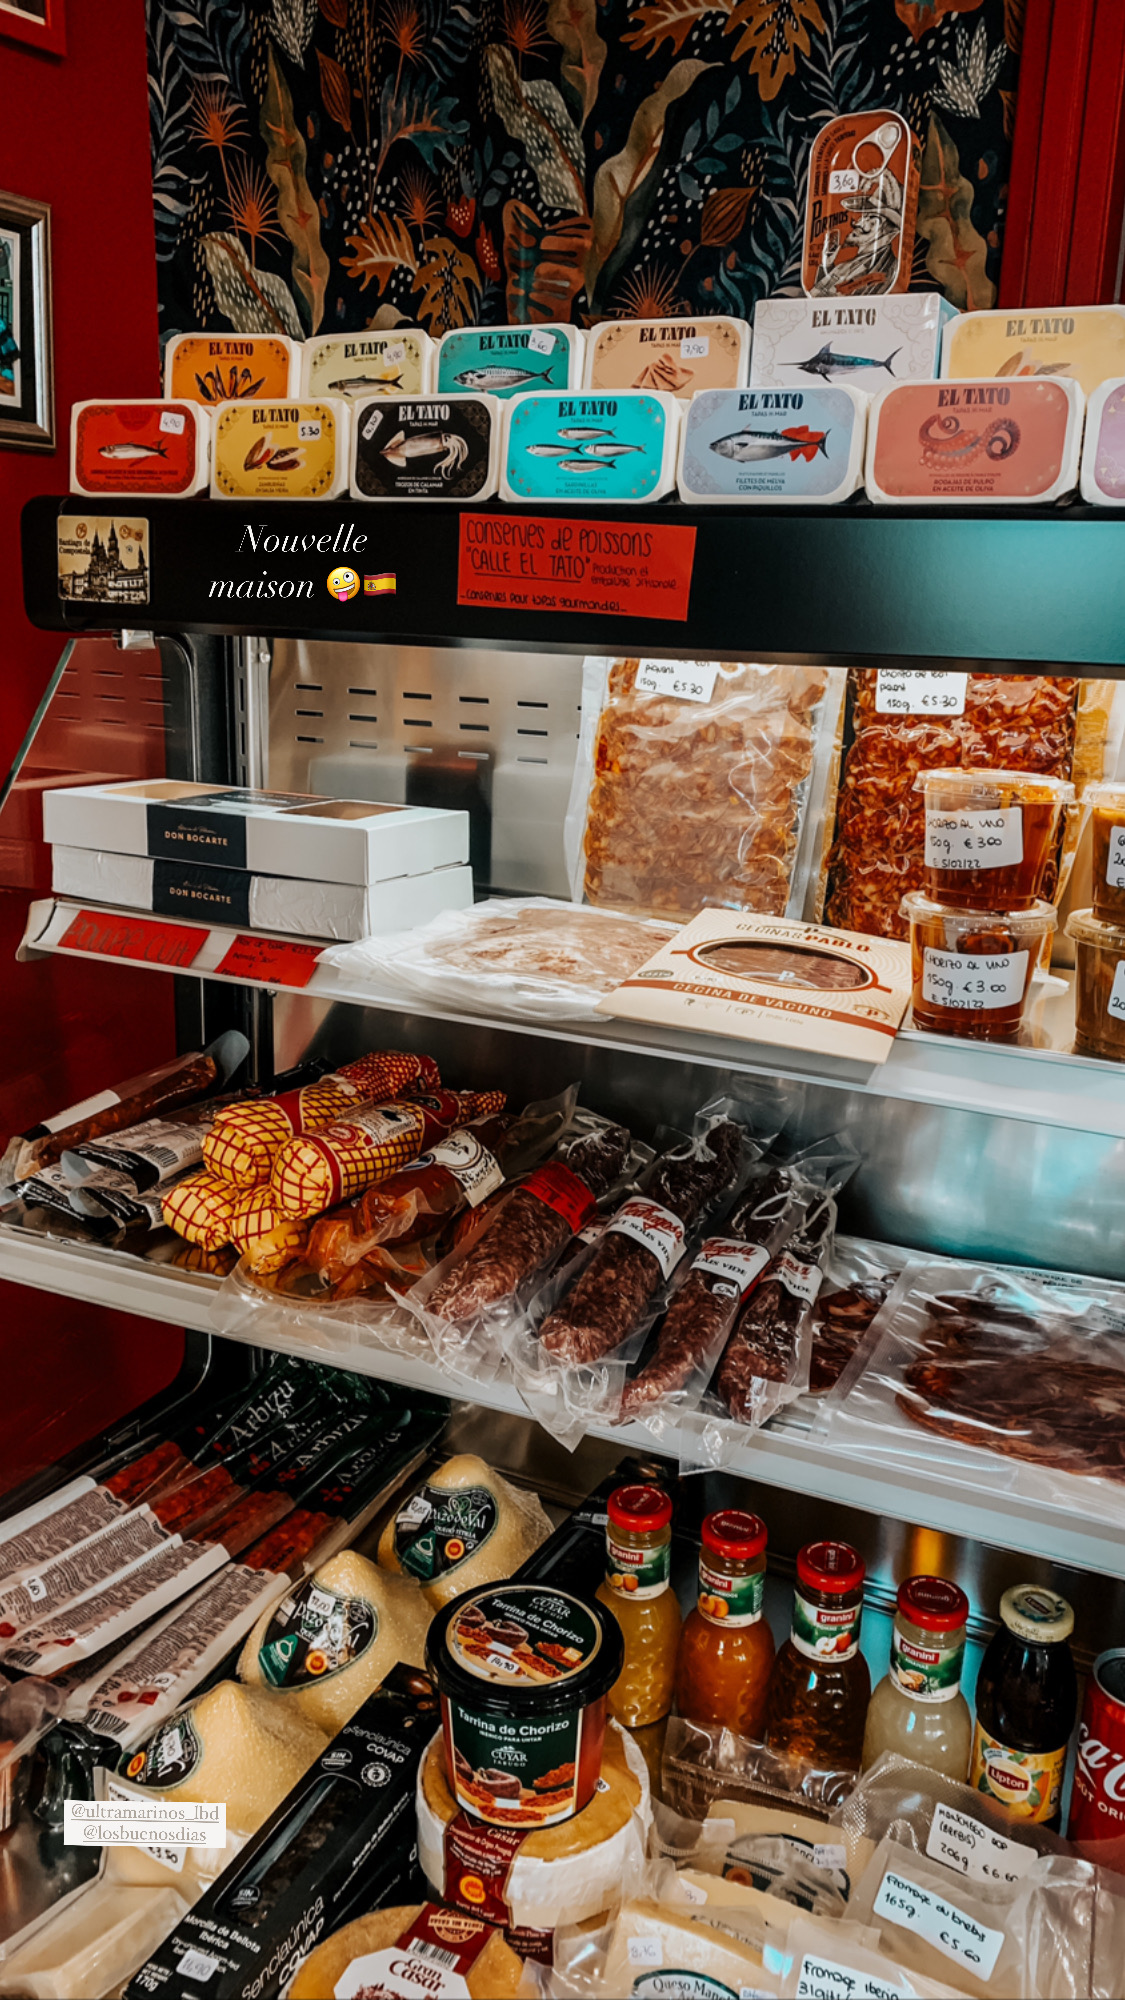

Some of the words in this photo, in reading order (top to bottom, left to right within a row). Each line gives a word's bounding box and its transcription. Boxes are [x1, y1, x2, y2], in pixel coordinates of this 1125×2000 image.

[812, 309, 831, 328] EL
[832, 308, 877, 327] TATO
[1006, 319, 1025, 337] EL
[1027, 317, 1075, 335] TATO
[479, 335, 496, 351] EL
[497, 333, 530, 349] TATO
[639, 327, 658, 343] EL
[659, 326, 696, 341] TATO
[209, 342, 222, 357] EL
[223, 341, 254, 356] TATO
[344, 343, 359, 359] EL
[359, 341, 388, 356] TATO
[738, 393, 759, 411] EL
[761, 392, 803, 411] TATO
[938, 388, 960, 407] EL
[963, 387, 1011, 406] TATO
[252, 408, 267, 424] EL
[268, 407, 300, 424] TATO
[398, 405, 415, 422] EL
[416, 404, 450, 421] TATO
[557, 400, 577, 418] EL
[578, 400, 618, 417] TATO
[520, 552, 537, 575] EL
[164, 830, 184, 841] DON
[186, 833, 229, 847] BOCARTE
[169, 886, 189, 897] DON
[191, 890, 232, 905] BOCARTE
[736, 922, 802, 939] CECINAS
[804, 934, 873, 953] PABLO
[672, 982, 733, 1000] CECINA
[738, 993, 759, 1005] DE
[765, 997, 833, 1019] VACUNO
[722, 1262, 748, 1277] VIDE
[230, 1380, 296, 1447] Arbizu
[701, 1571, 728, 1588] granini
[532, 1600, 571, 1618] CUYAR
[820, 1612, 854, 1623] granini
[491, 1599, 526, 1617] Tarrina
[527, 1612, 542, 1623] de
[542, 1619, 584, 1644] Chorizo
[902, 1643, 935, 1662] granini
[458, 1706, 496, 1733] Tarrina
[499, 1724, 516, 1736] de
[519, 1719, 570, 1736] Chorizo
[343, 1726, 412, 1756] esenciaúnica
[366, 1743, 405, 1764] COVAP
[491, 1749, 528, 1762] CUYAR
[989, 1768, 1026, 1790] Lipton
[1098, 1803, 1125, 1821] ORI
[487, 1828, 521, 1846] Casar
[184, 1914, 218, 1932] Morcilla
[218, 1926, 230, 1937] de
[230, 1930, 261, 1954] Bellota
[199, 1931, 230, 1950] Ibérica
[278, 1917, 325, 1987] COVAP
[389, 1959, 441, 1992] Casar
[407, 1958, 442, 1980] Gran
[802, 1960, 856, 1991] Fromage
[135, 1974, 160, 1992] 170g
[653, 1978, 691, 1991] Queso
